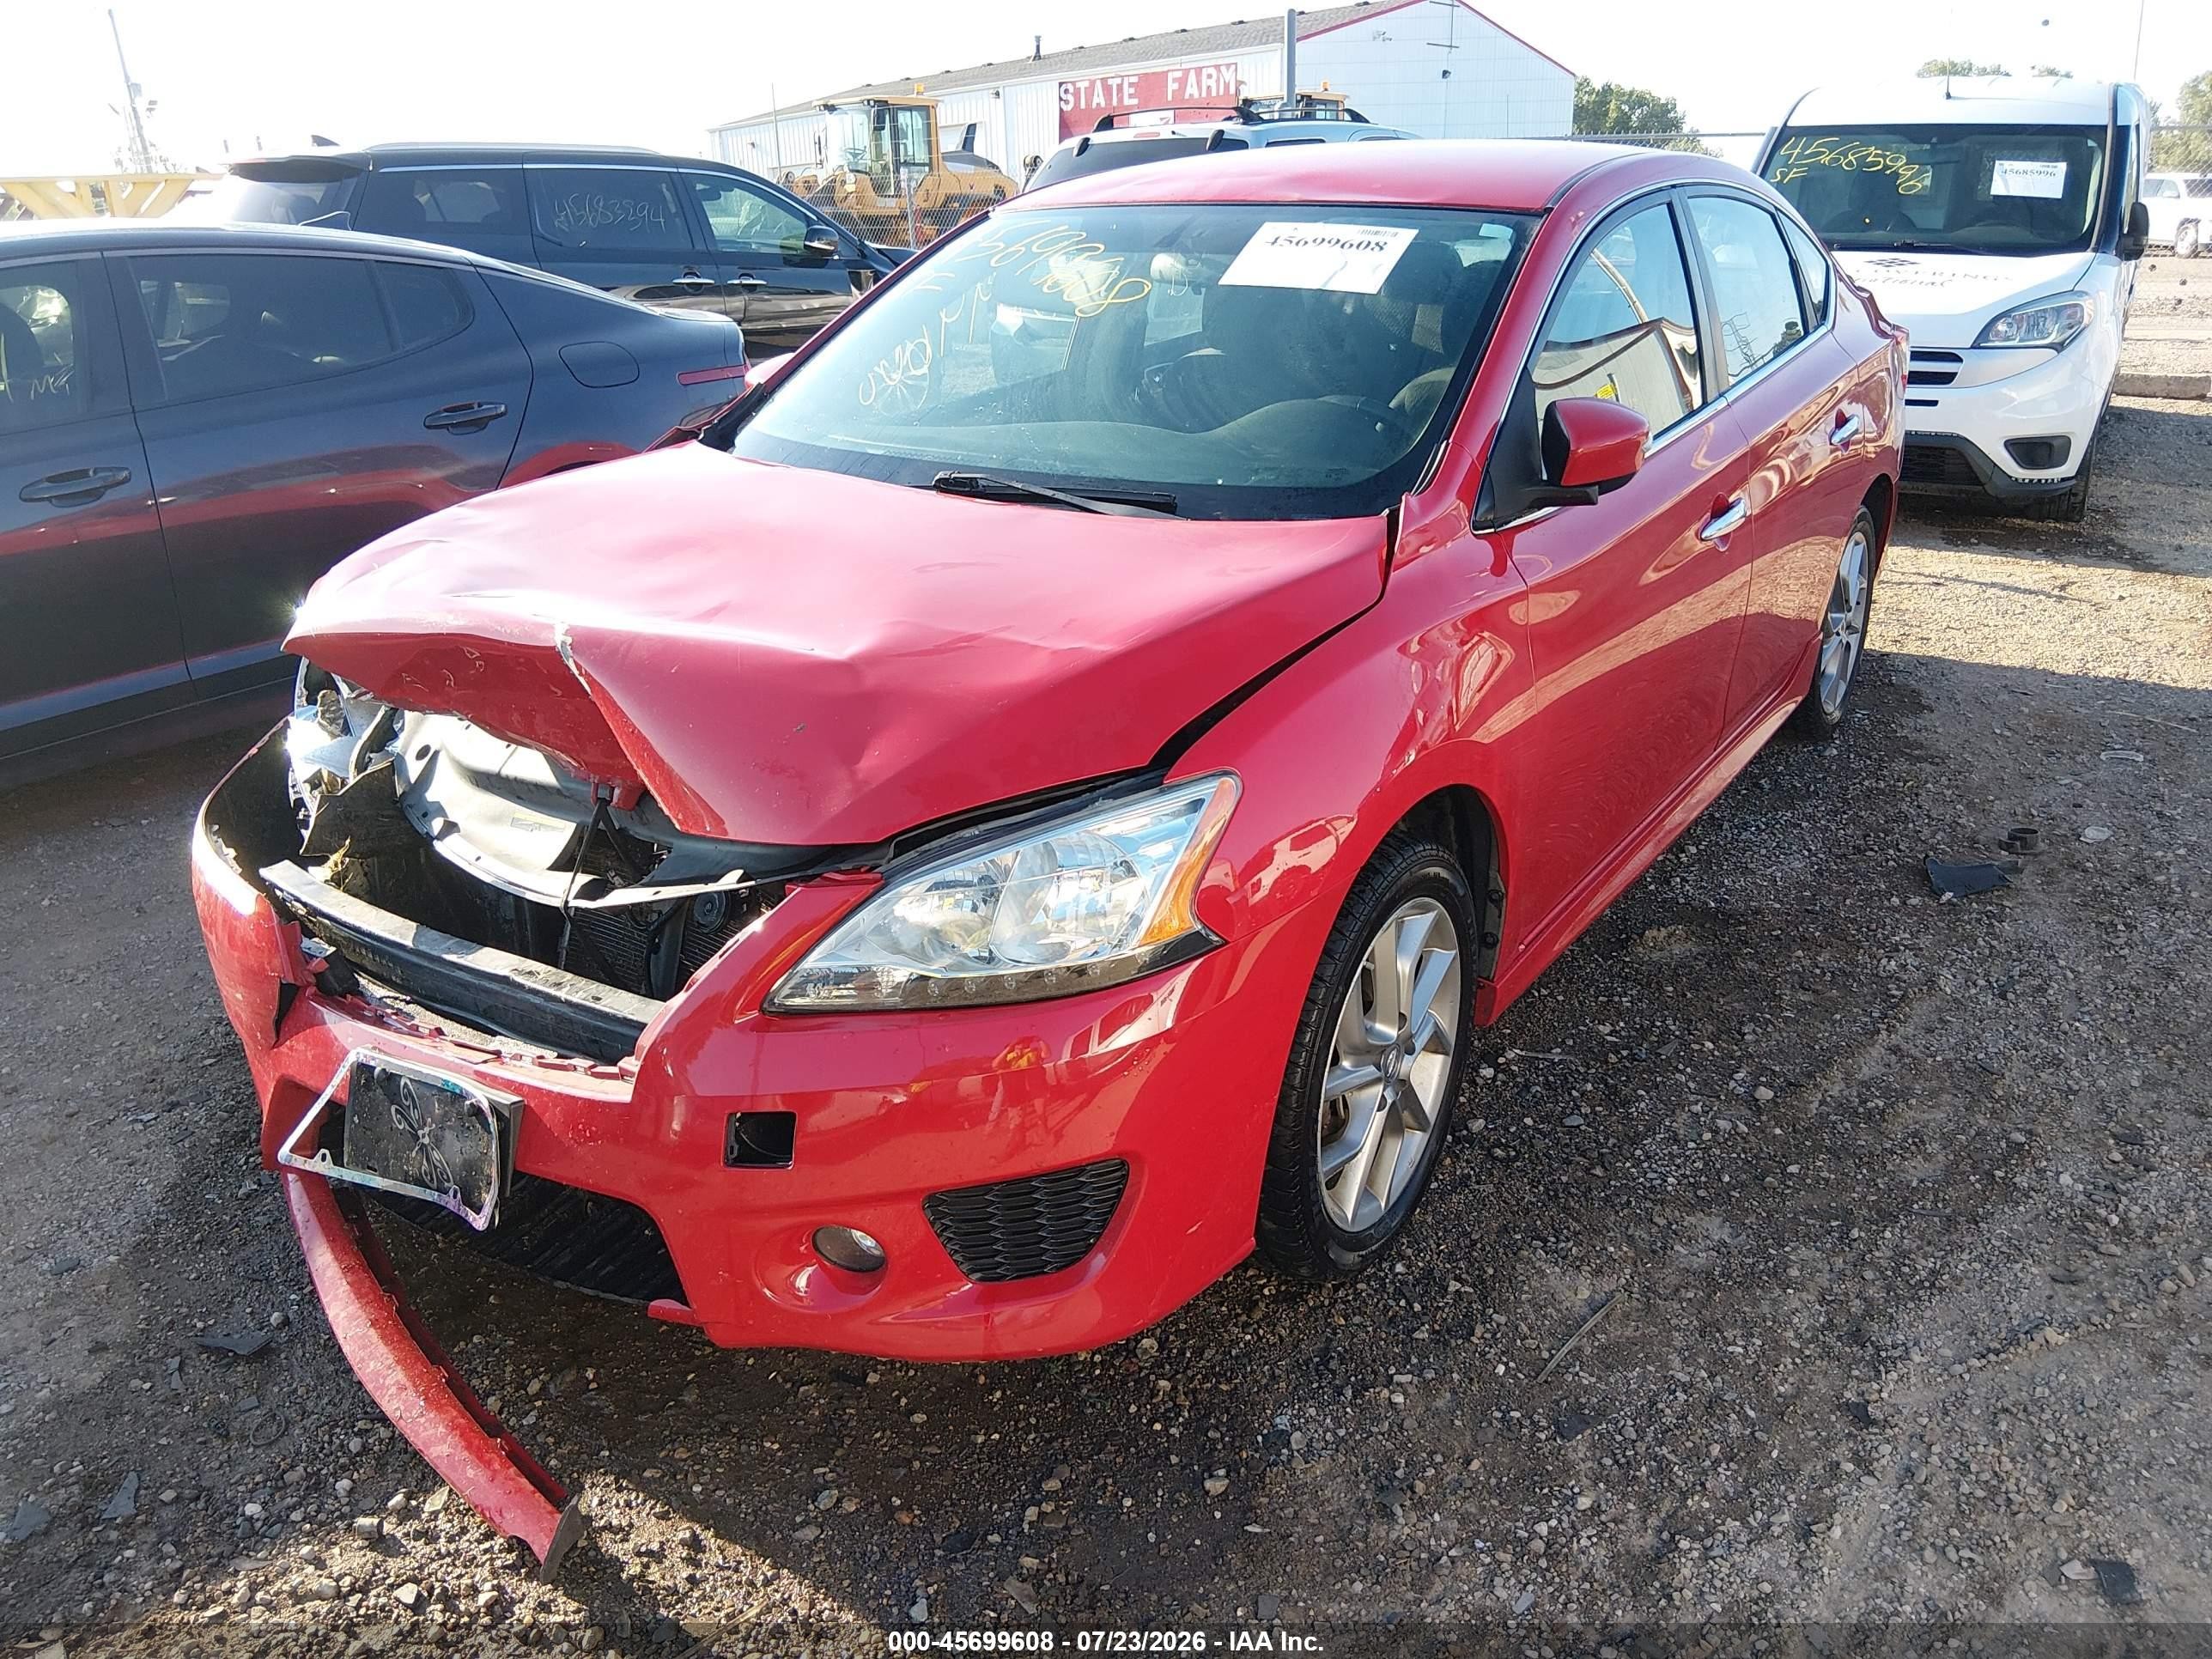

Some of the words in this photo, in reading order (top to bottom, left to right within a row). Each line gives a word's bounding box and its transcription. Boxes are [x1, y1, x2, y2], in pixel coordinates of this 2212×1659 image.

[1060, 75, 1139, 112] STATE
[1166, 64, 1237, 101] FARM
[1264, 234, 1389, 252] 45699608
